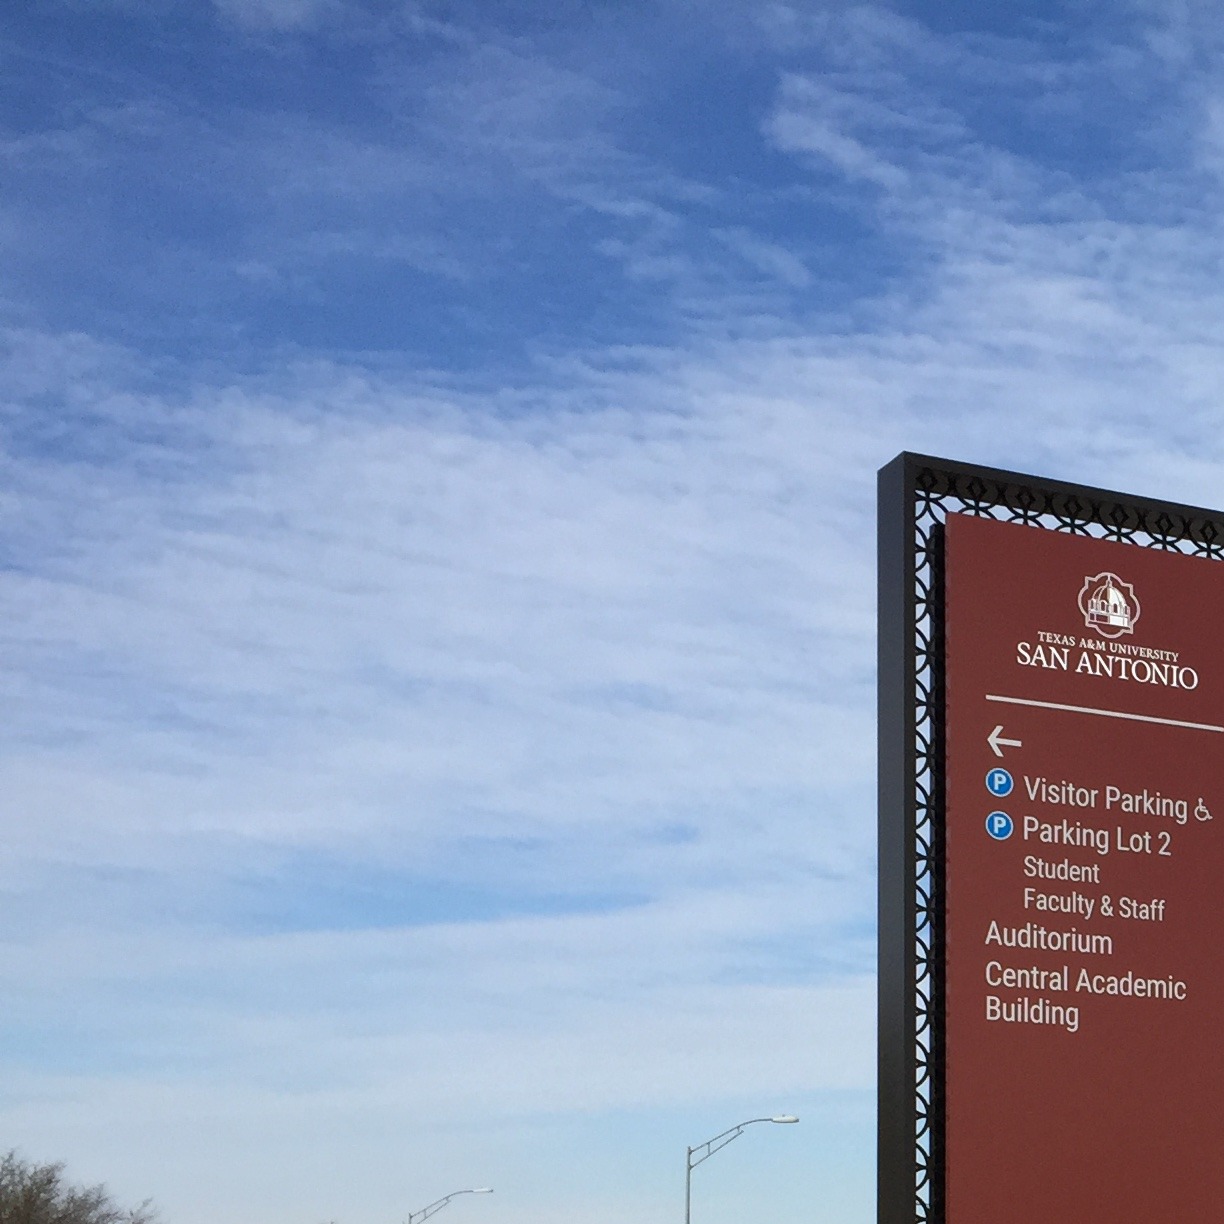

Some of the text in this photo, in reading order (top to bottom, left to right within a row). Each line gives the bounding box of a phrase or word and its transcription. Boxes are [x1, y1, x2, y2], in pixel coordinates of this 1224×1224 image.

[1016, 642, 1199, 690] SAN ANTONIO
[1037, 631, 1179, 663] TEXAS A&M UNIVERSITY
[1023, 775, 1099, 808] Visitor
[1105, 786, 1188, 825] Parking
[1023, 816, 1109, 855] Parking
[1117, 826, 1152, 854] Lot
[1158, 831, 1172, 856] 2
[1023, 855, 1100, 884] Student
[1024, 888, 1166, 921] Faculty & Staff
[985, 920, 1113, 955] Auditorium
[985, 961, 1187, 1000] Central Academic
[985, 995, 1079, 1033] Building
